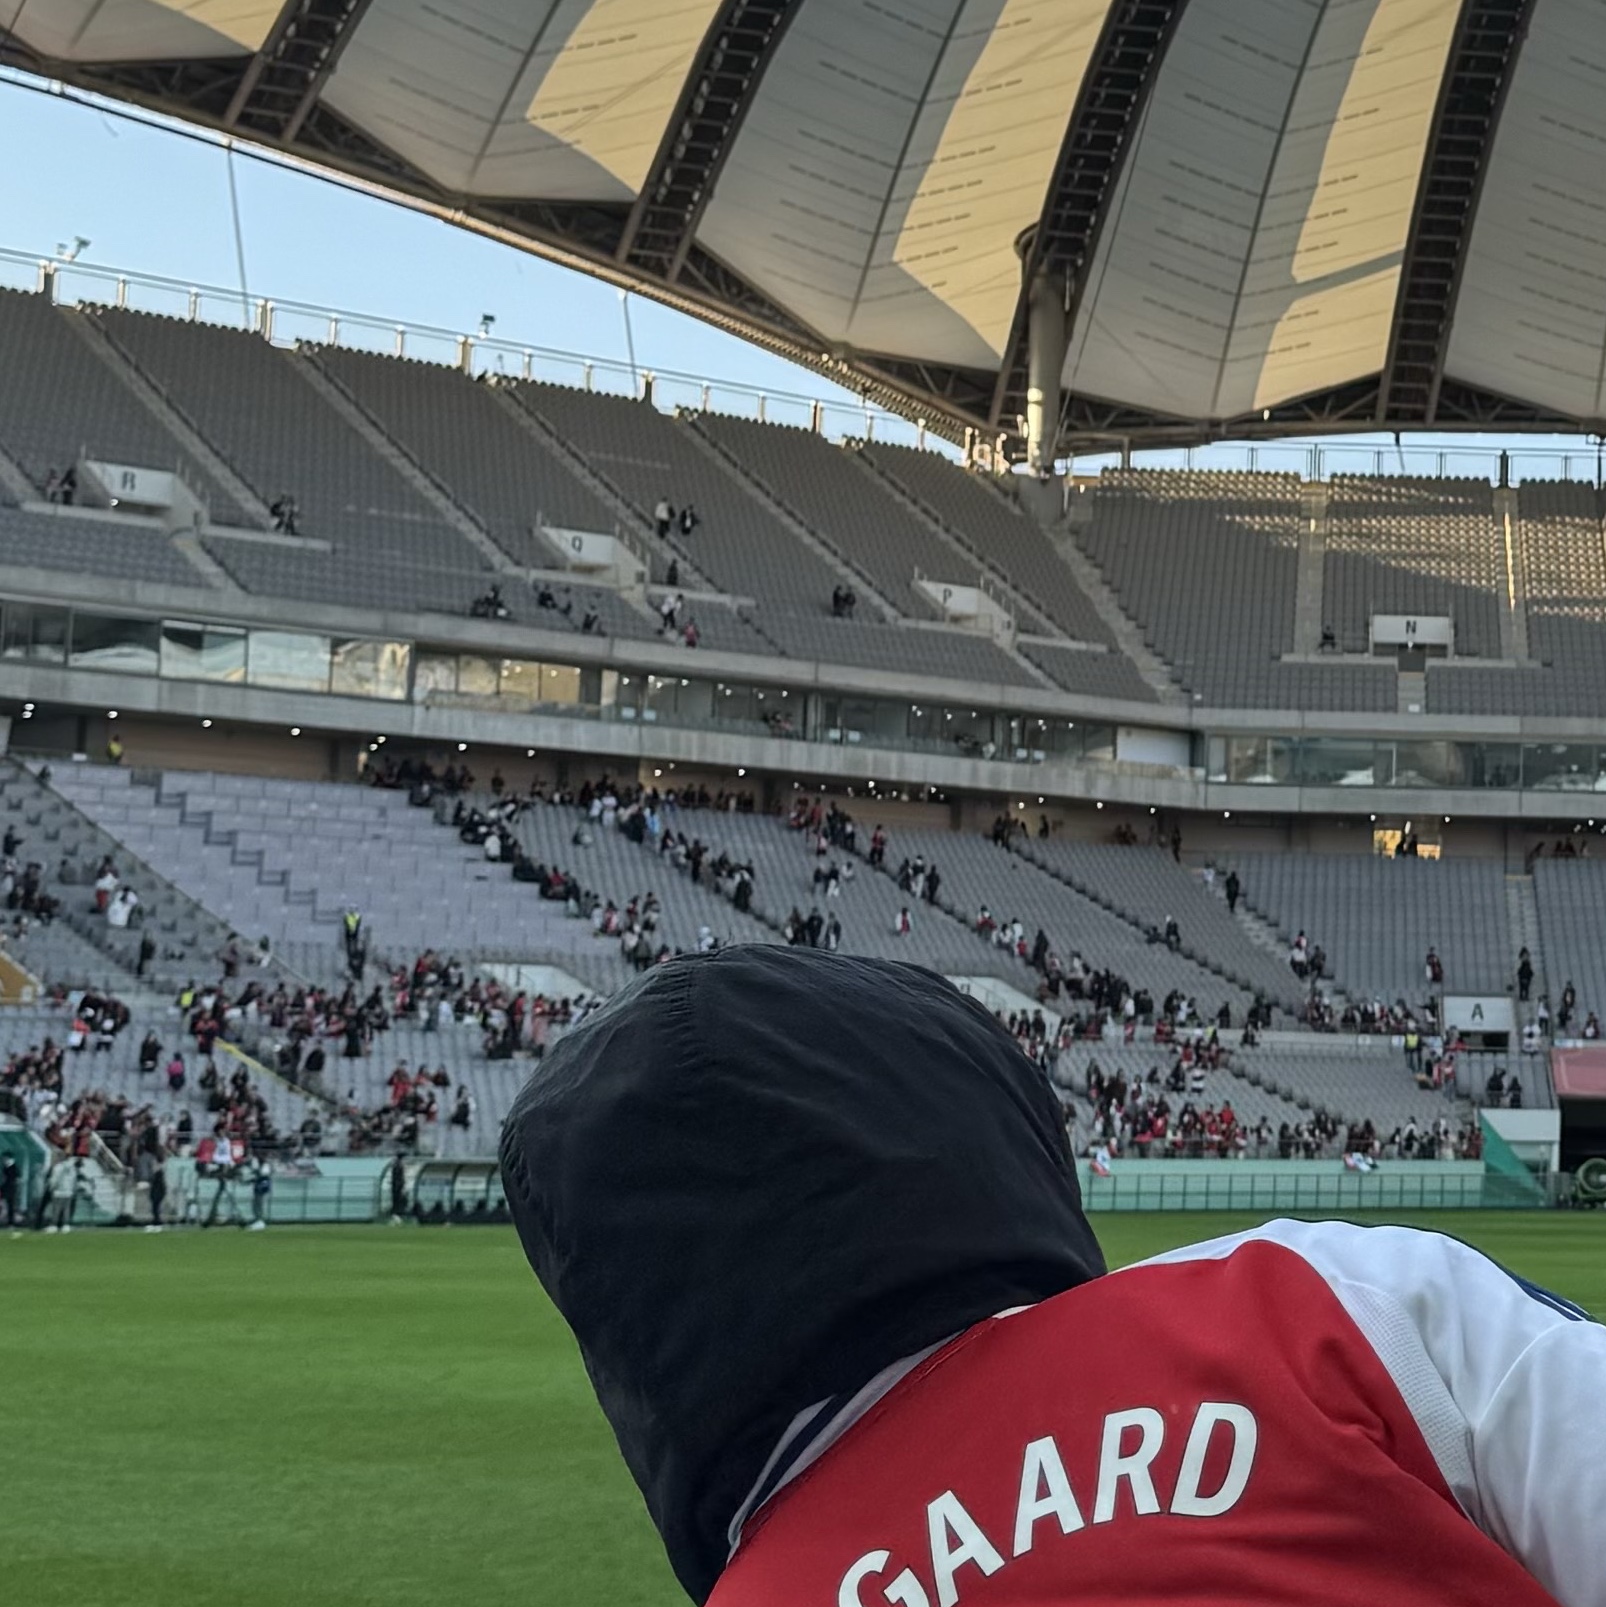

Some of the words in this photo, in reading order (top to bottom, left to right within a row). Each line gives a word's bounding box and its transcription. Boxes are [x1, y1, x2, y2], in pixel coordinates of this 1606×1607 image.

[571, 536, 584, 552] Q
[1406, 620, 1417, 634] N
[1471, 1003, 1484, 1021] A
